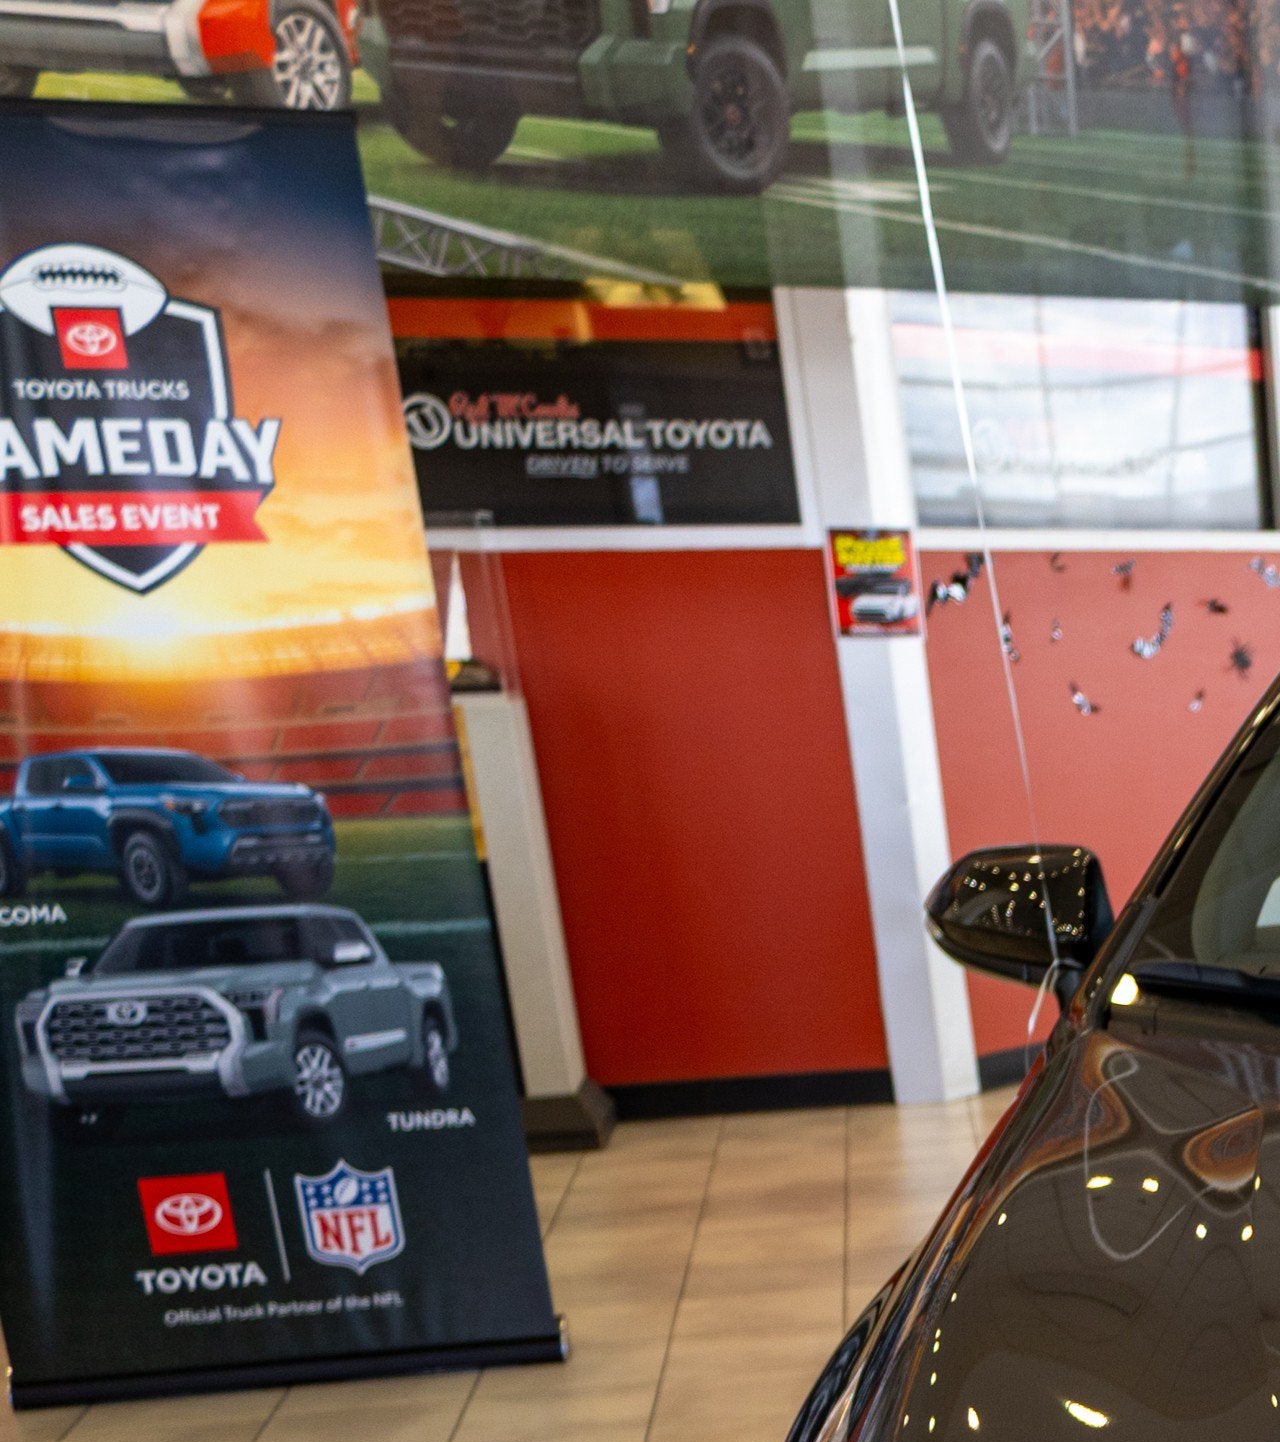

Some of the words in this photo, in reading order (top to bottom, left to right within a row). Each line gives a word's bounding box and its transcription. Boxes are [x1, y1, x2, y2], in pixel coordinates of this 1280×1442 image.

[13, 378, 102, 400] TOYOTA
[103, 378, 191, 401] TRUCKS
[453, 419, 647, 449] UNIVERSAL
[647, 418, 774, 449] TOYOTA
[19, 504, 117, 533] SALES
[121, 502, 221, 531] EVENT
[386, 1107, 477, 1132] TUNDRA
[314, 1208, 393, 1256] NFL
[135, 1260, 268, 1295] TOYOTA
